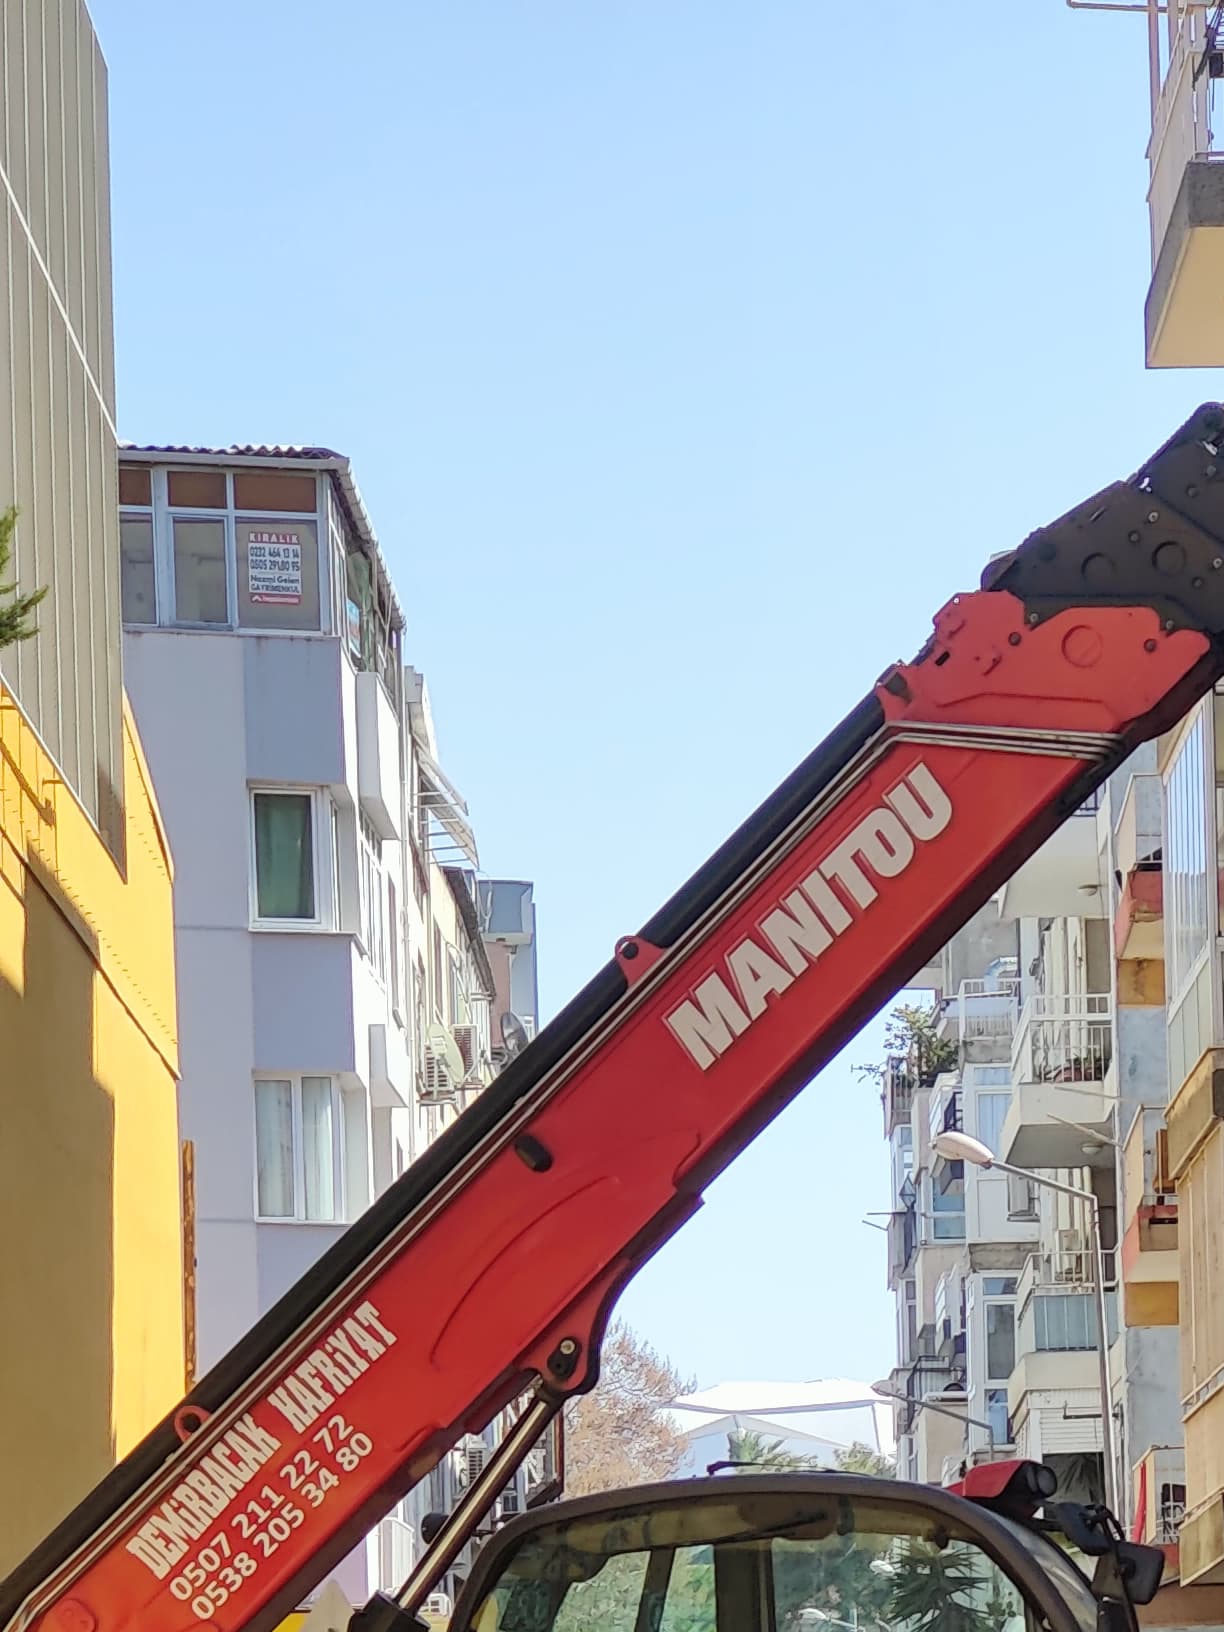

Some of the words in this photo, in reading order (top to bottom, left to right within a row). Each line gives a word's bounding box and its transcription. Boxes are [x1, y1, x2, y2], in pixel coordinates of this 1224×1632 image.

[249, 533, 298, 544] KIRALIK
[663, 760, 953, 1072] MANITOU
[170, 1532, 231, 1600] 0507
[231, 1485, 284, 1539] 211
[279, 1450, 319, 1489] 22
[313, 1415, 353, 1453] 72
[191, 1552, 257, 1620] 0538
[253, 1503, 304, 1557] 205
[301, 1467, 340, 1507] 34
[335, 1432, 373, 1472] 80
